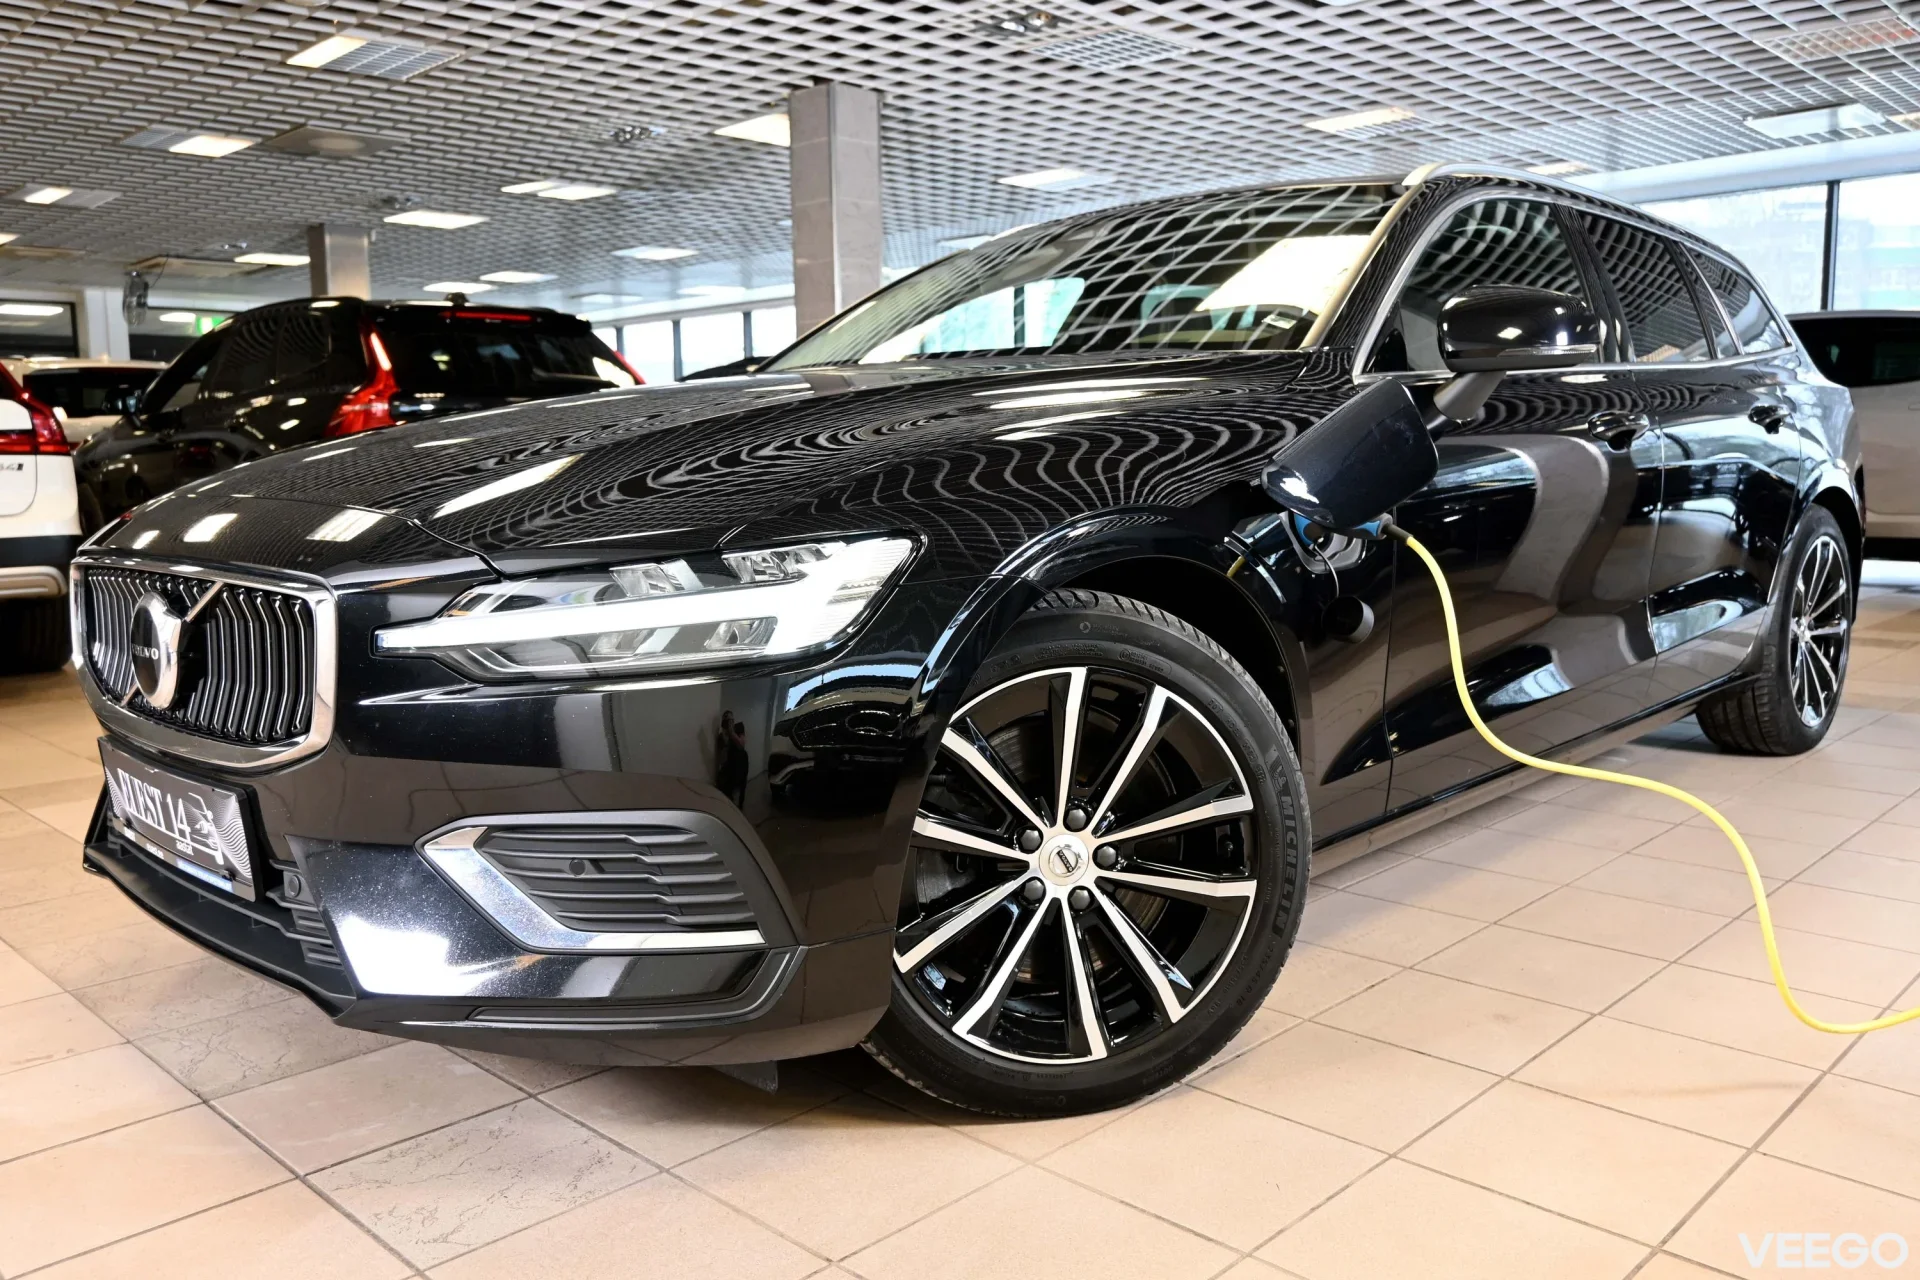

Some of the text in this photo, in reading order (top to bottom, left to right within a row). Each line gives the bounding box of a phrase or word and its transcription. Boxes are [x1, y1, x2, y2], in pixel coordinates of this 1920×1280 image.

[132, 644, 159, 660] VOLVO
[167, 793, 191, 842] 14
[1274, 795, 1297, 932] MICHELIN
